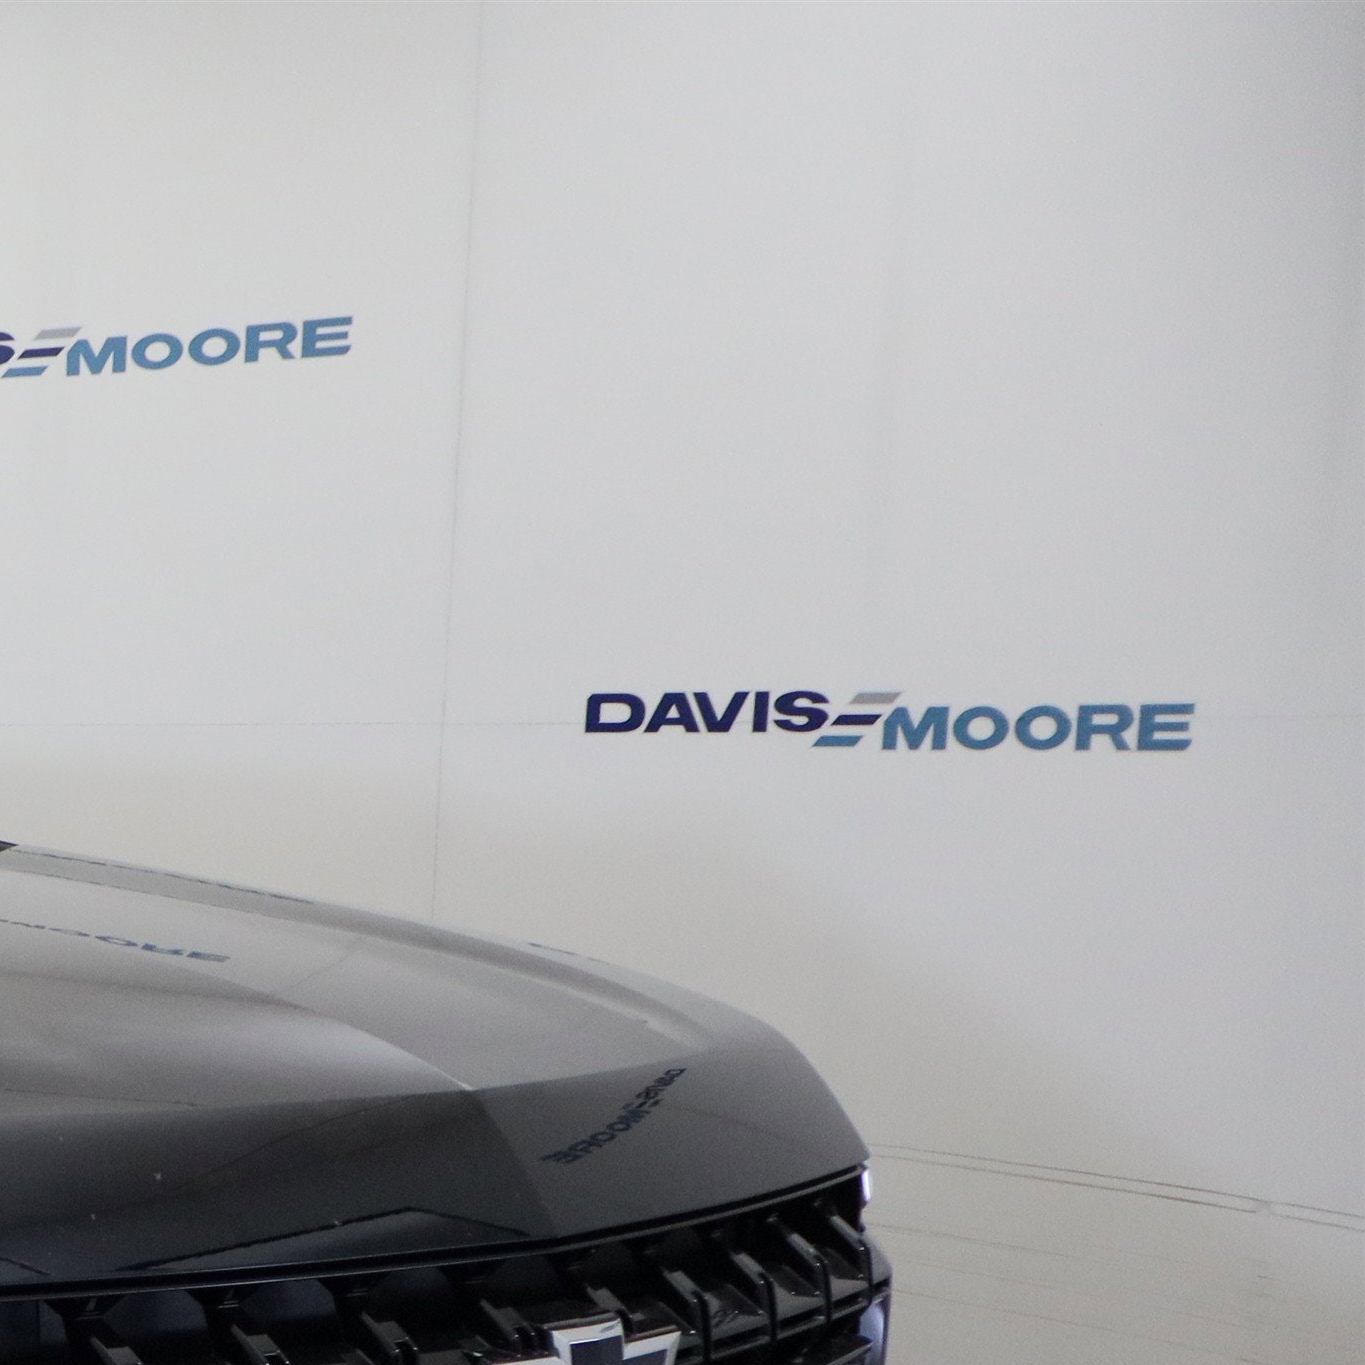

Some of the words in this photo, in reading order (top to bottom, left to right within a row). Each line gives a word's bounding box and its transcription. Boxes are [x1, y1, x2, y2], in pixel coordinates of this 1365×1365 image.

[66, 316, 353, 377] MOORE
[585, 690, 830, 733] DAVIS
[882, 703, 1195, 751] MOORE
